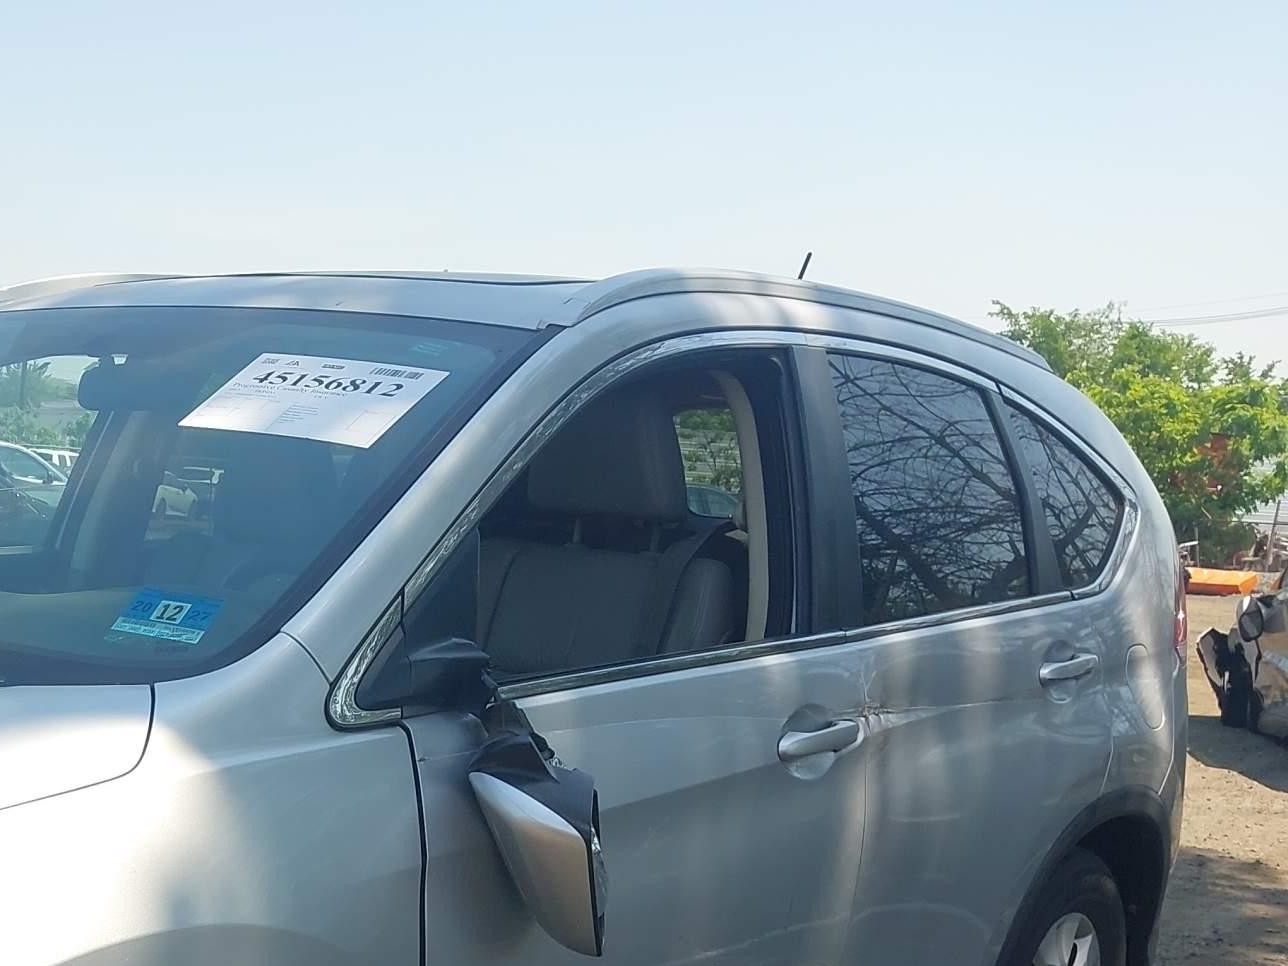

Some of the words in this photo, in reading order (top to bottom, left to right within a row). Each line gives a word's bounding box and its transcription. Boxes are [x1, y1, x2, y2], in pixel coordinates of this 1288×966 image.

[253, 370, 404, 397] 45156812
[132, 600, 152, 613] 20
[155, 603, 184, 621] 12
